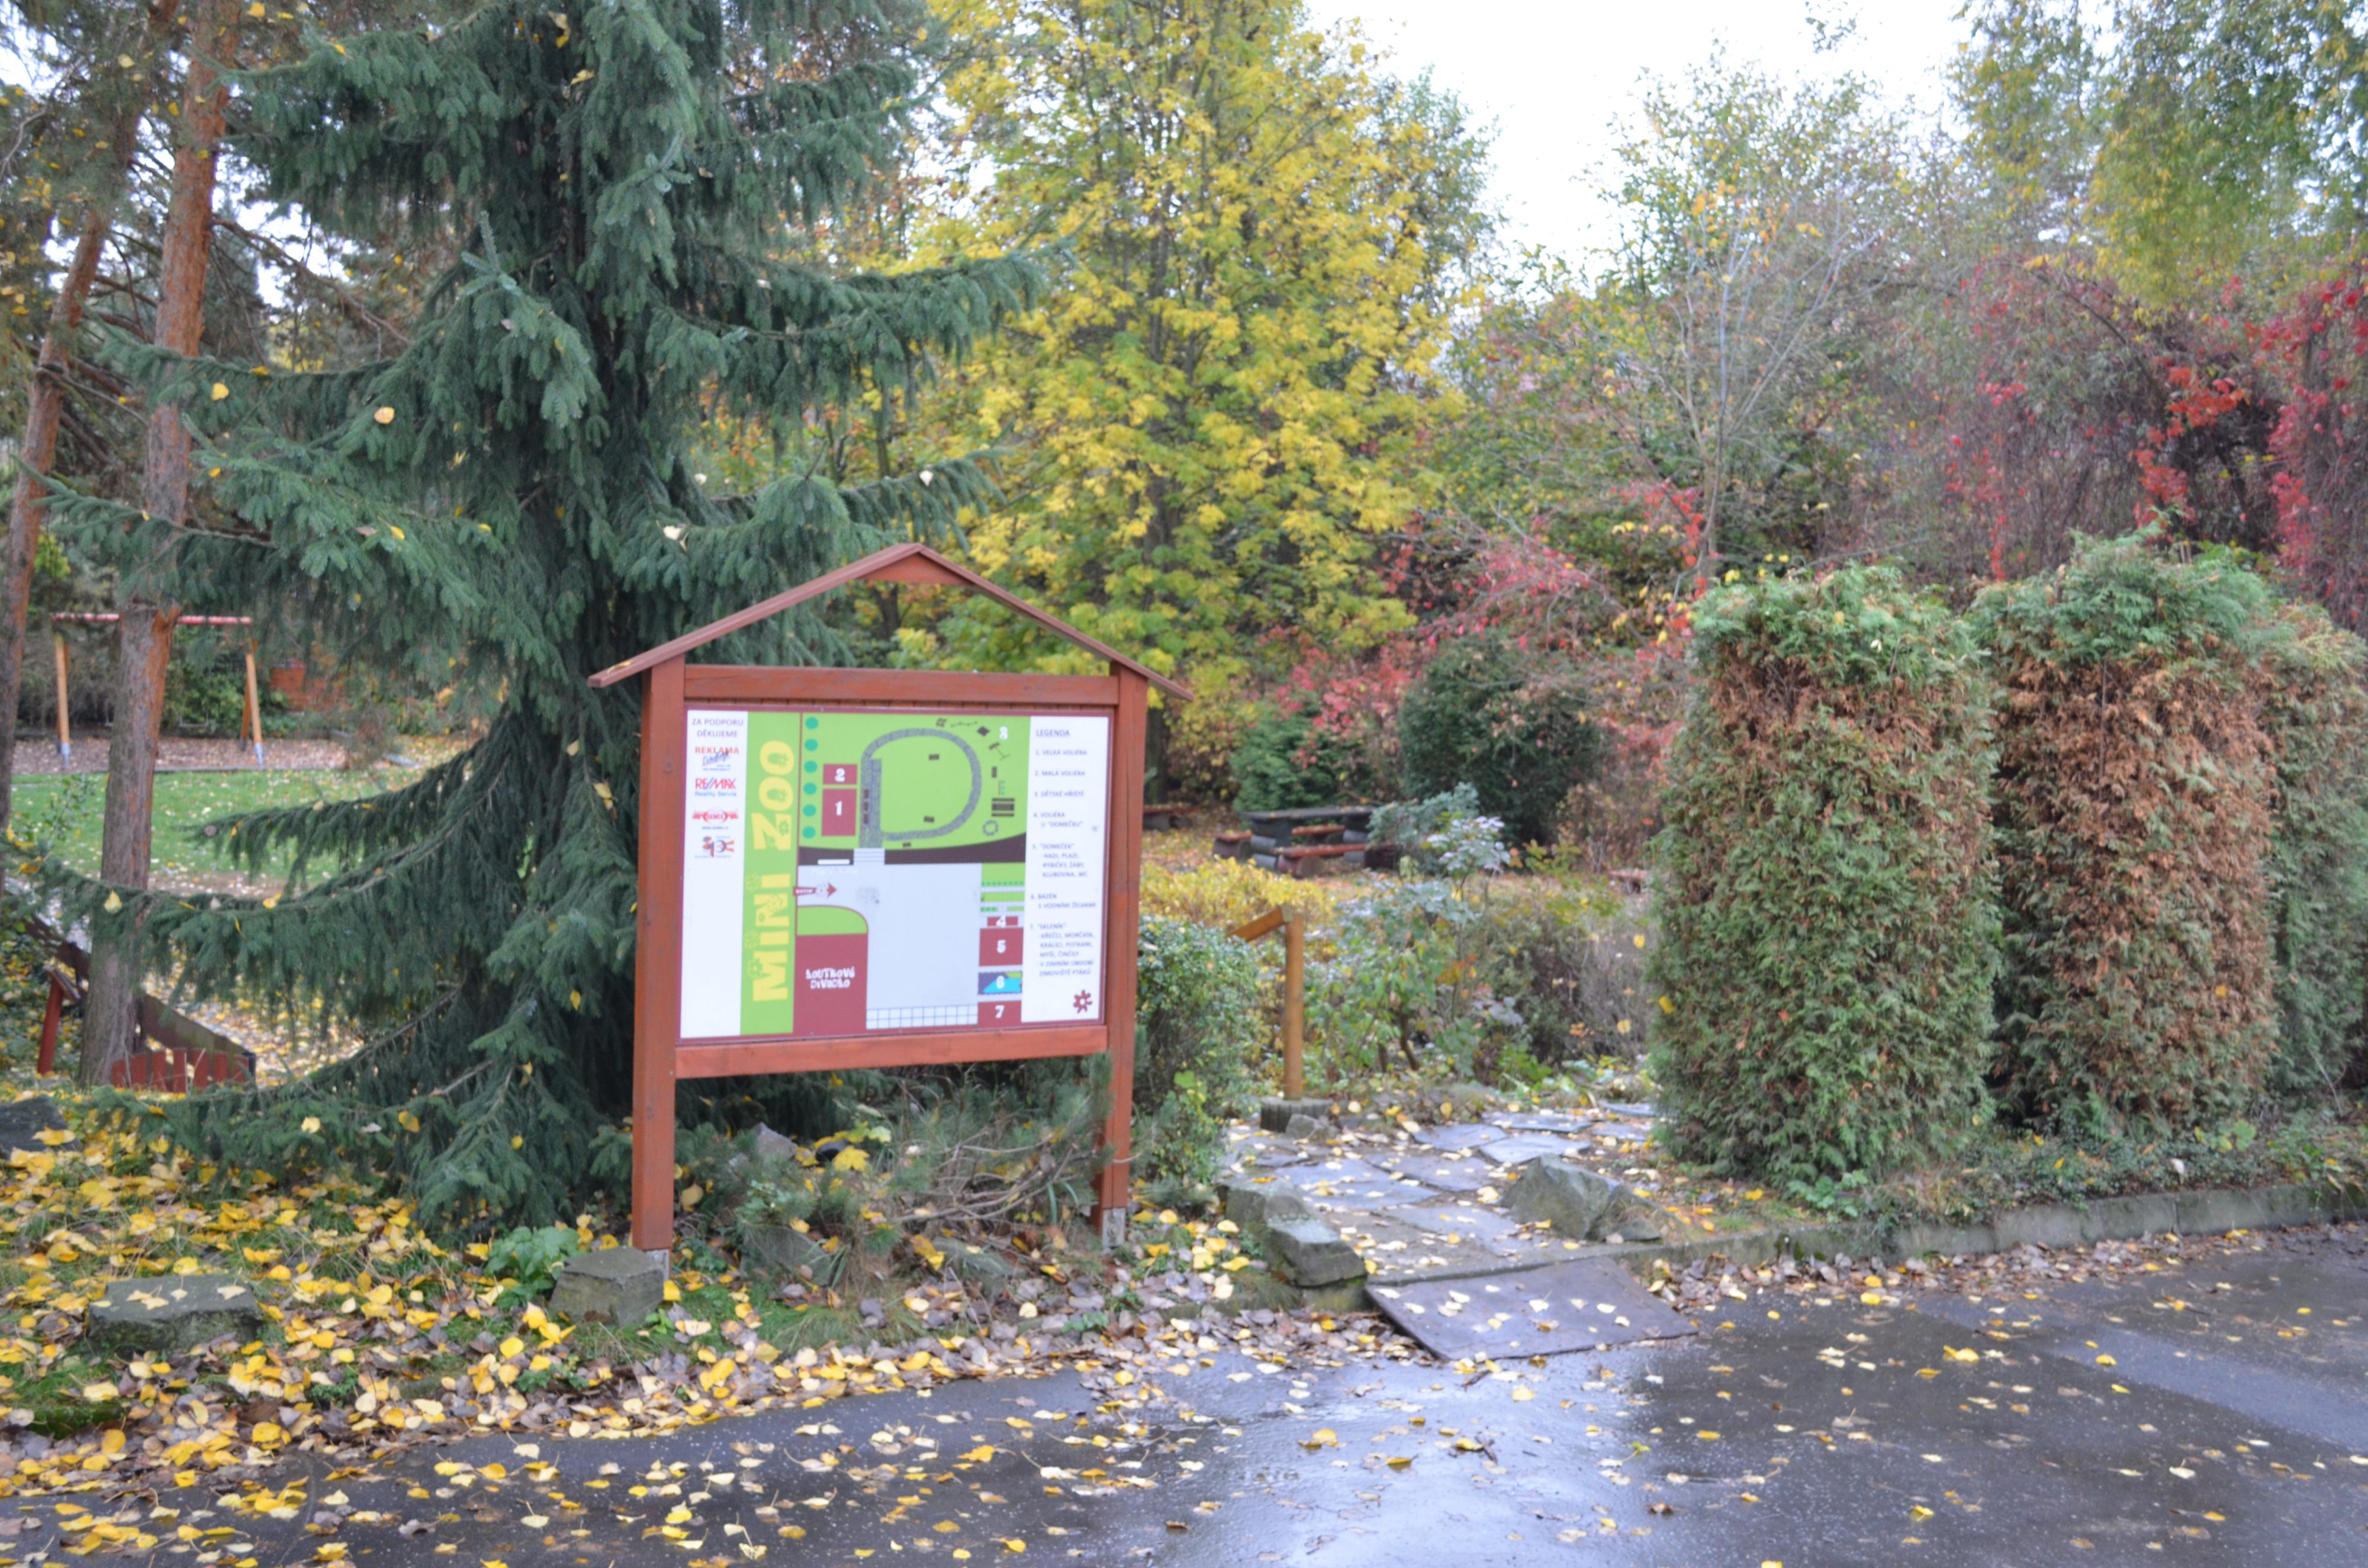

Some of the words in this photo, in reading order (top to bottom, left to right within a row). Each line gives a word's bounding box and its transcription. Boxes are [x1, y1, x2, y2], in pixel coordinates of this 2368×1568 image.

[1035, 729, 1070, 738] LEGENDA
[835, 768, 845, 783] 2
[751, 740, 794, 851] ZOO
[835, 801, 843, 816] 1
[997, 939, 1006, 954] 5
[996, 975, 1005, 989] 6
[995, 1004, 1005, 1019] 7
